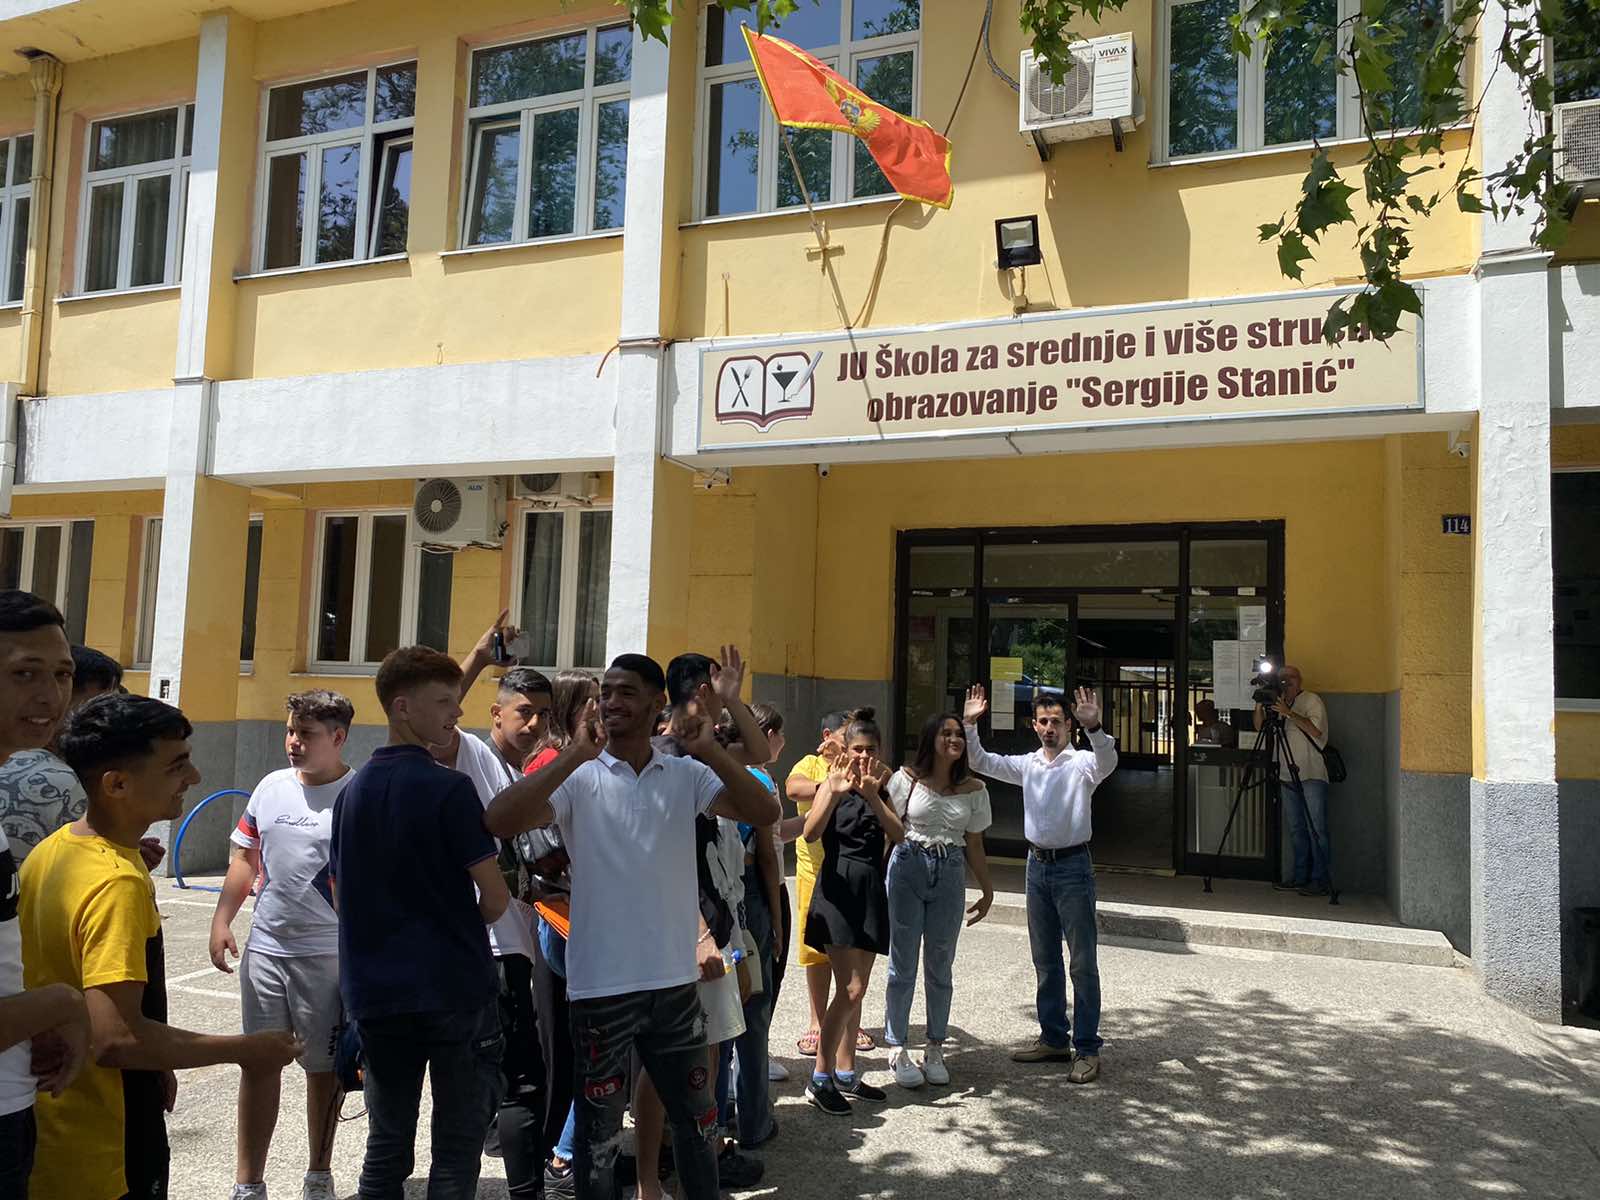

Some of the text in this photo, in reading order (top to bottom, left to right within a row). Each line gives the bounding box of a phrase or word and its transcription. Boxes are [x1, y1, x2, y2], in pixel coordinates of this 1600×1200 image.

[1098, 46, 1128, 57] VIVAX
[836, 350, 868, 382] JU
[875, 343, 959, 379] Škola
[965, 344, 999, 371] za
[1006, 328, 1137, 364] srednje
[1145, 325, 1156, 357] i
[1163, 319, 1238, 356] više
[866, 358, 1356, 423] obrazovanje "Sergije Stanić"
[1446, 517, 1469, 533] 114
